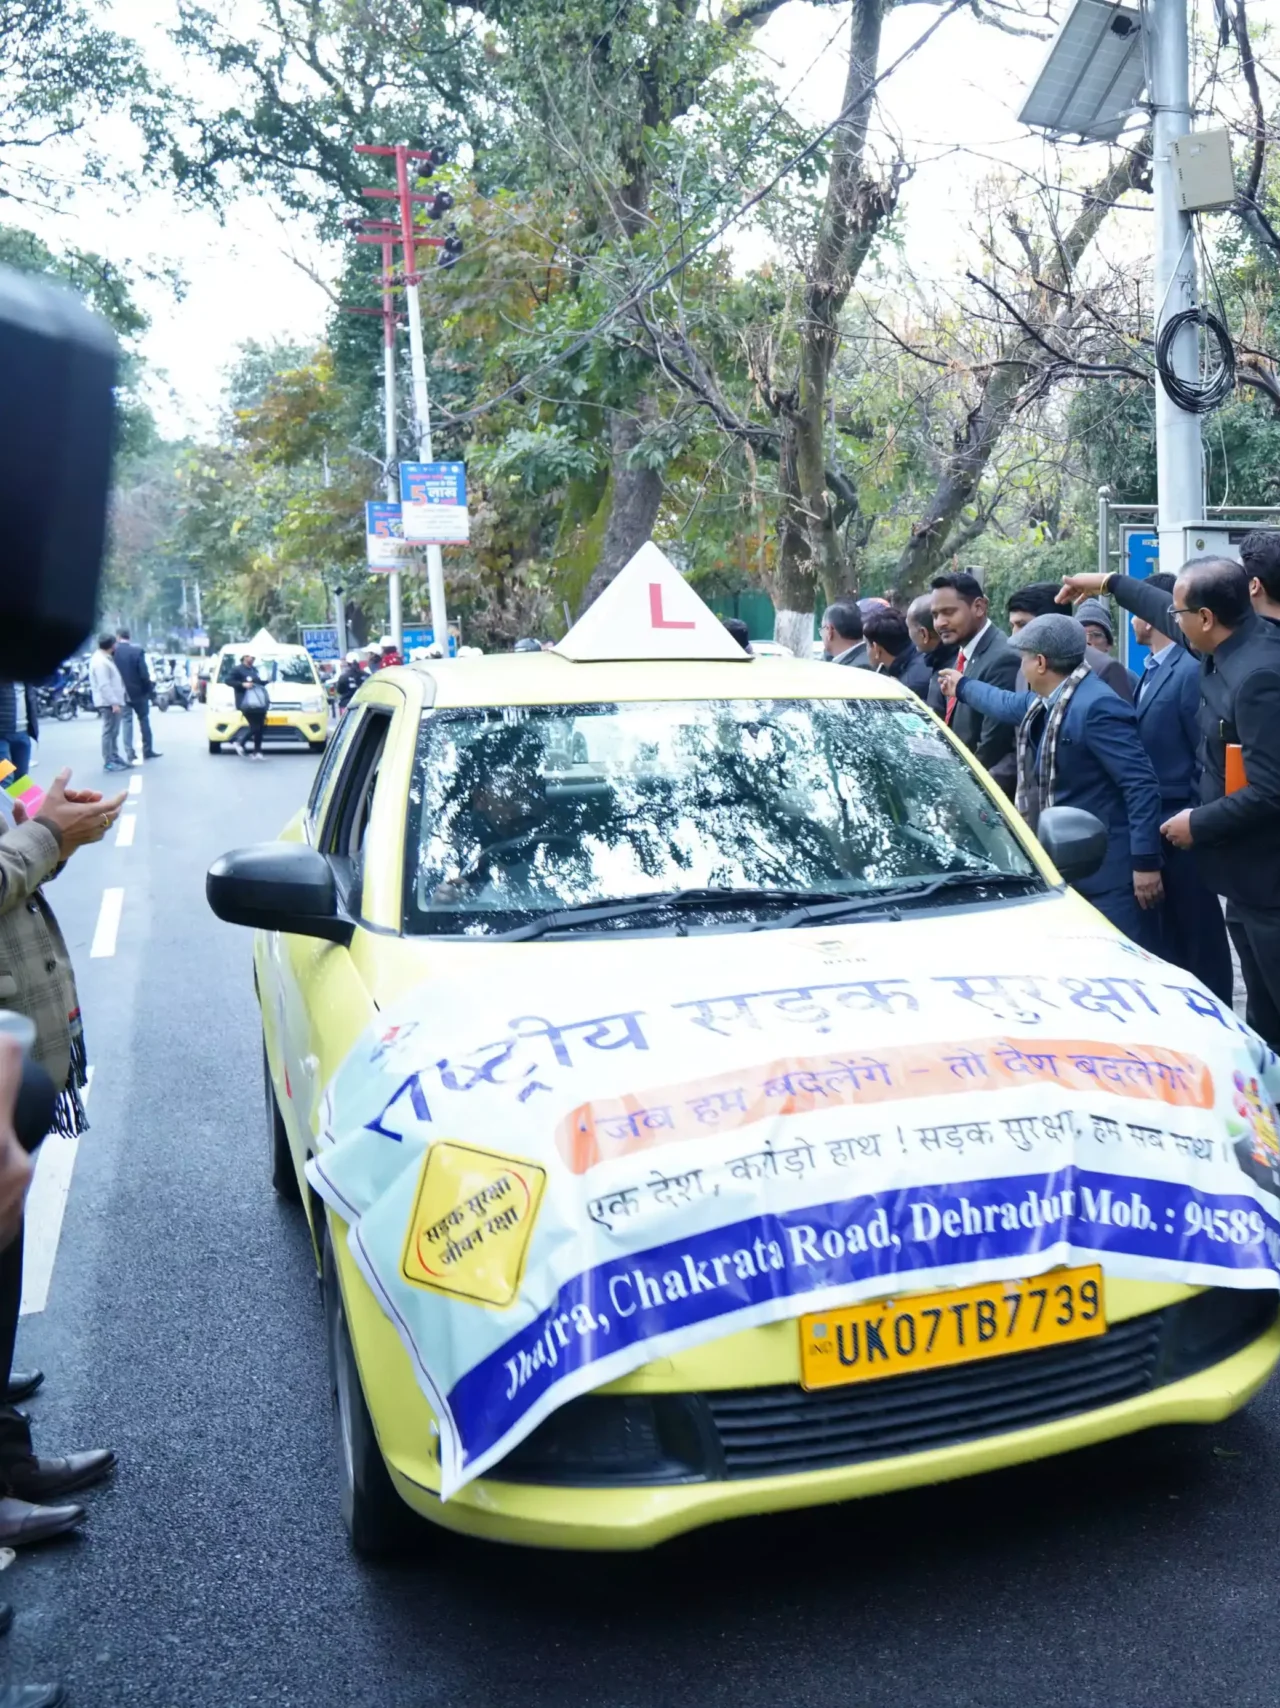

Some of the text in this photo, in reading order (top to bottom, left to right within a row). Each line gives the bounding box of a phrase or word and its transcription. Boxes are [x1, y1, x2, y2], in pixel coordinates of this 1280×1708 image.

[411, 485, 428, 507] 5
[375, 521, 389, 539] 5
[649, 583, 695, 629] L
[671, 979, 919, 1034] सड़क
[930, 974, 1161, 1025] सुरक्षा
[685, 1086, 749, 1125] हम
[760, 1056, 890, 1097] बदलेंगे
[944, 1047, 991, 1080] तो
[587, 1186, 640, 1232] एक
[830, 1131, 884, 1168] हाथ
[914, 1121, 994, 1156] सड़क
[1089, 1114, 1122, 1144] हम
[424, 1177, 511, 1244] सड़क सुरक्षा
[439, 1205, 518, 1264] जीवन रक्षा
[609, 1236, 785, 1319] Chakrata
[787, 1207, 901, 1266] Road,
[1079, 1186, 1158, 1232] Mob.
[835, 1280, 1099, 1366] UK07TB7739
